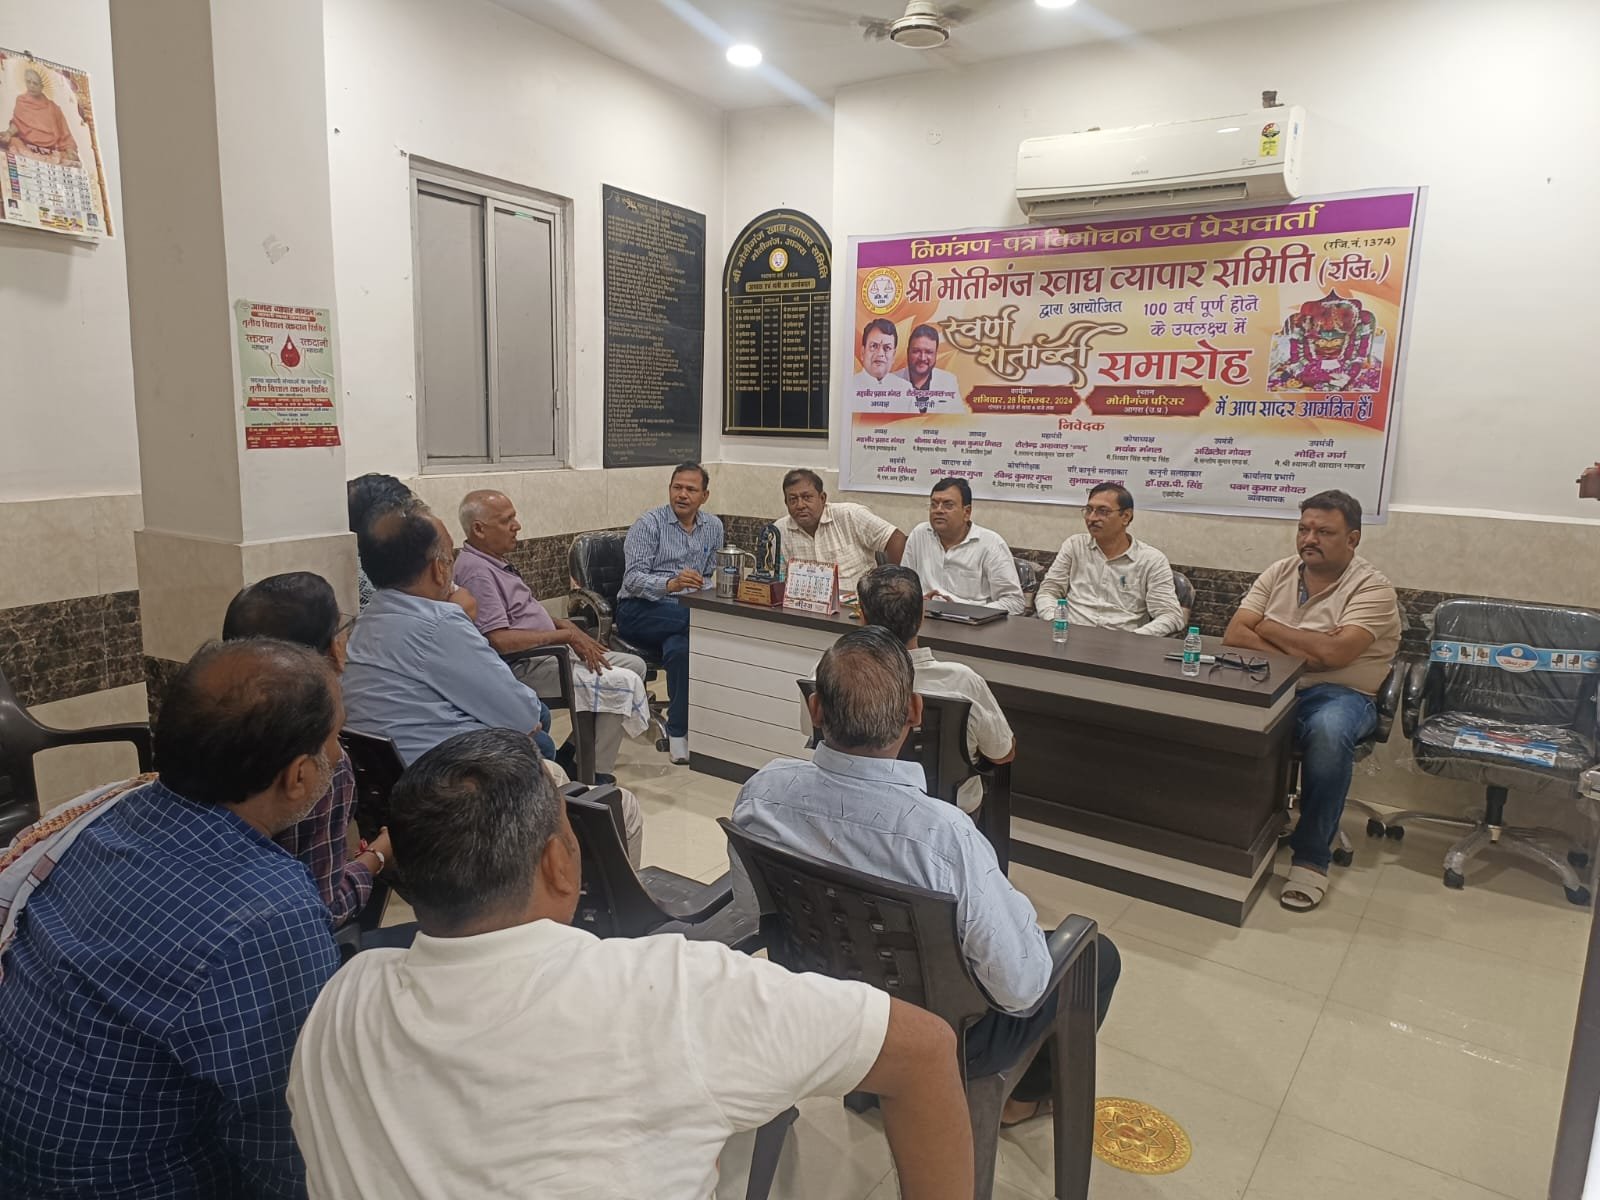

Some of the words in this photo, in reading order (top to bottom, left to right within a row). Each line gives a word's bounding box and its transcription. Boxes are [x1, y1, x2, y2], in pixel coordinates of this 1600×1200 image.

[1044, 225, 1143, 249] विमोचन
[1150, 216, 1195, 241] एवं
[1200, 203, 1325, 238] प्रेसवार्ता
[906, 269, 932, 302] श्री
[937, 263, 1036, 301] मोतीगंज
[1039, 266, 1105, 298] खाद्य
[1110, 260, 1208, 291] व्यापार
[1213, 243, 1316, 288] समिति
[1318, 254, 1391, 285] (रजि.)
[1039, 303, 1063, 319] द्वारा
[1068, 298, 1122, 316] आयोजित
[1144, 302, 1168, 316] 100
[1173, 295, 1195, 314] वर्ष
[1200, 294, 1228, 318] पूर्ण
[1230, 295, 1259, 312] होने
[940, 305, 1019, 354] स्वर्ण
[1150, 320, 1166, 337] के
[1172, 322, 1228, 338] उपलक्ष्य
[1233, 318, 1248, 335] में
[1098, 340, 1253, 384] समारोह
[1055, 397, 1073, 405] 2024
[1106, 395, 1149, 405] मोतीगंज
[1151, 394, 1185, 406] परिसर
[1215, 395, 1229, 416] में
[1229, 400, 1256, 417] आप
[1259, 400, 1296, 417] सादर
[1298, 395, 1355, 418] आमंत्रित
[1058, 418, 1105, 431] निवेदक
[1139, 445, 1162, 454] मंगल
[1308, 438, 1334, 448] उपमंत्री
[1294, 449, 1324, 459] मोहित
[1327, 450, 1347, 460] गर्ग
[1243, 470, 1272, 481] कार्यालय
[1187, 480, 1205, 490] सिंह
[1230, 483, 1249, 491] पवन
[1251, 484, 1277, 494] कुमार
[1279, 484, 1306, 494] गोयल
